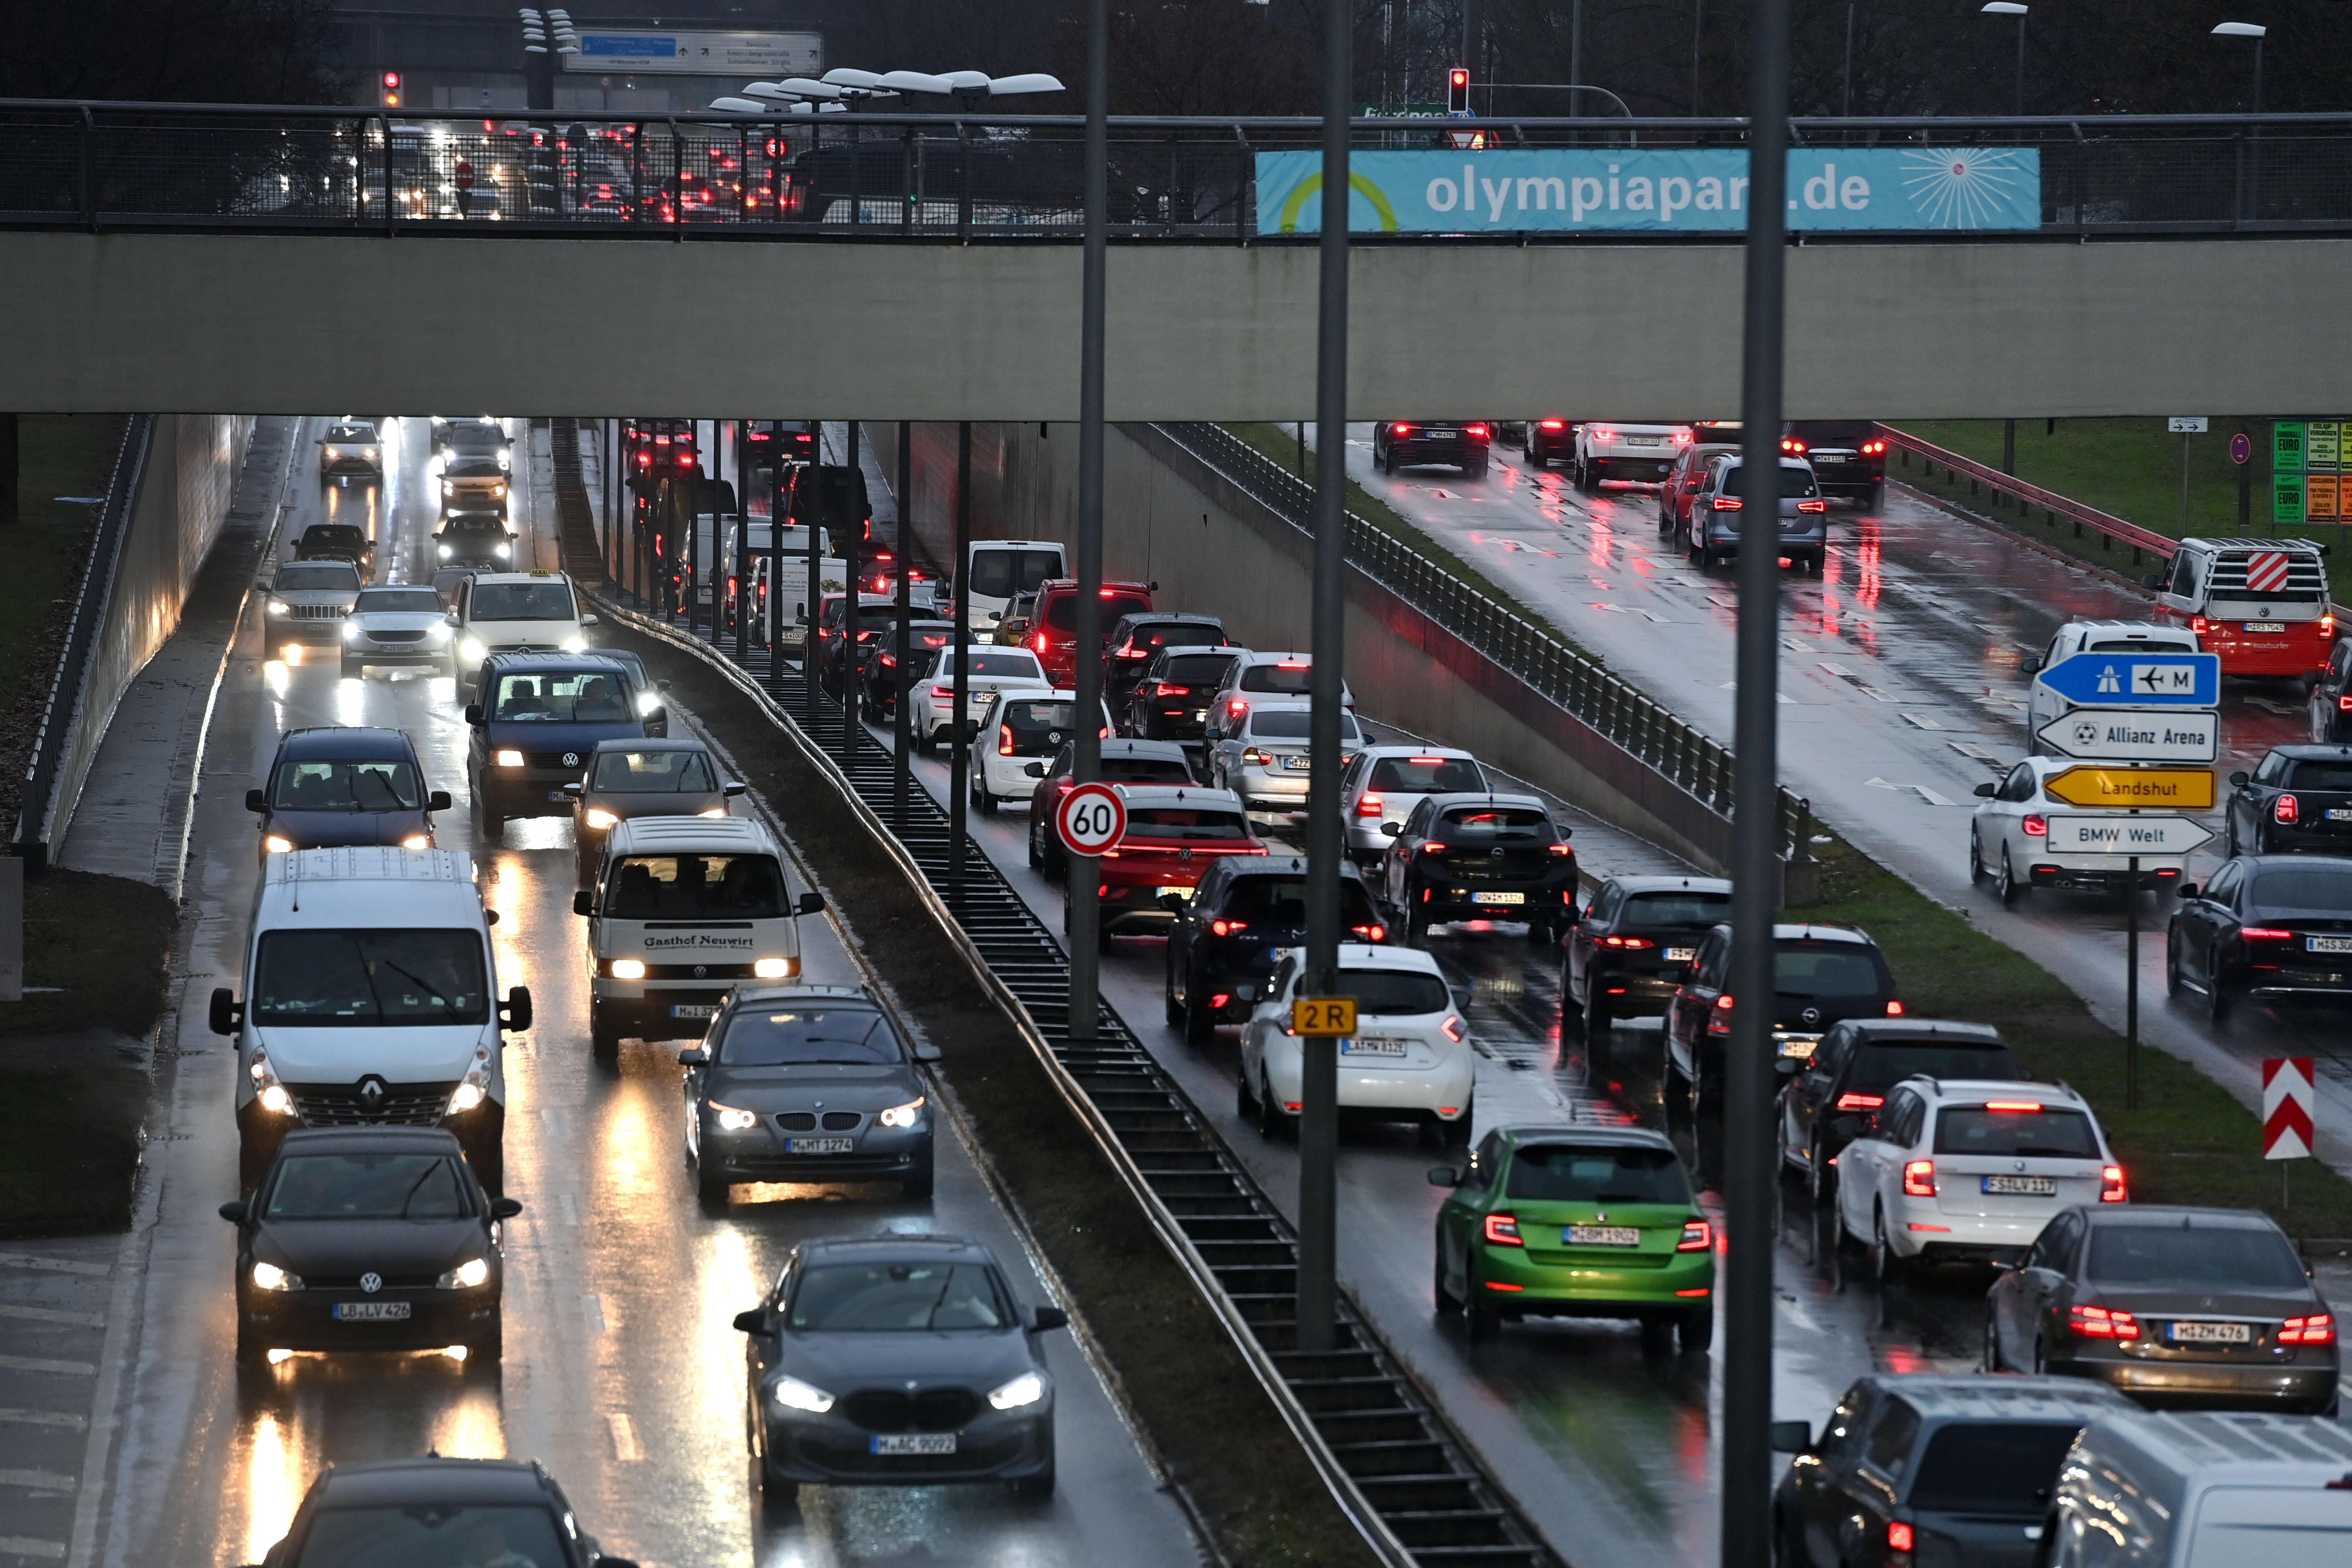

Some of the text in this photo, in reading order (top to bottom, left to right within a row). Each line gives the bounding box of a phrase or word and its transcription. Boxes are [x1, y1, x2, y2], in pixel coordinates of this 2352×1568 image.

[1426, 164, 1870, 222] olympiapar.de
[2278, 438, 2299, 451] EURO
[2278, 492, 2299, 504] EURO
[2173, 671, 2189, 688] M
[2106, 727, 2205, 745] Allianz Arena
[2102, 781, 2178, 796] Landshut
[1073, 804, 1110, 836] 60
[2079, 828, 2164, 842] BMW Welt
[1505, 894, 1523, 902] 1326
[644, 935, 754, 947] Gasthof Neuwirt
[2330, 940, 2336, 949] S
[680, 1007, 686, 1015] M
[1305, 1005, 1345, 1029] 2 R
[793, 1141, 799, 1150] M
[824, 1140, 852, 1149] 1274
[365, 1305, 382, 1318] LV
[385, 1305, 409, 1318] 426
[2180, 1327, 2188, 1337] M
[2219, 1327, 2243, 1338] 476
